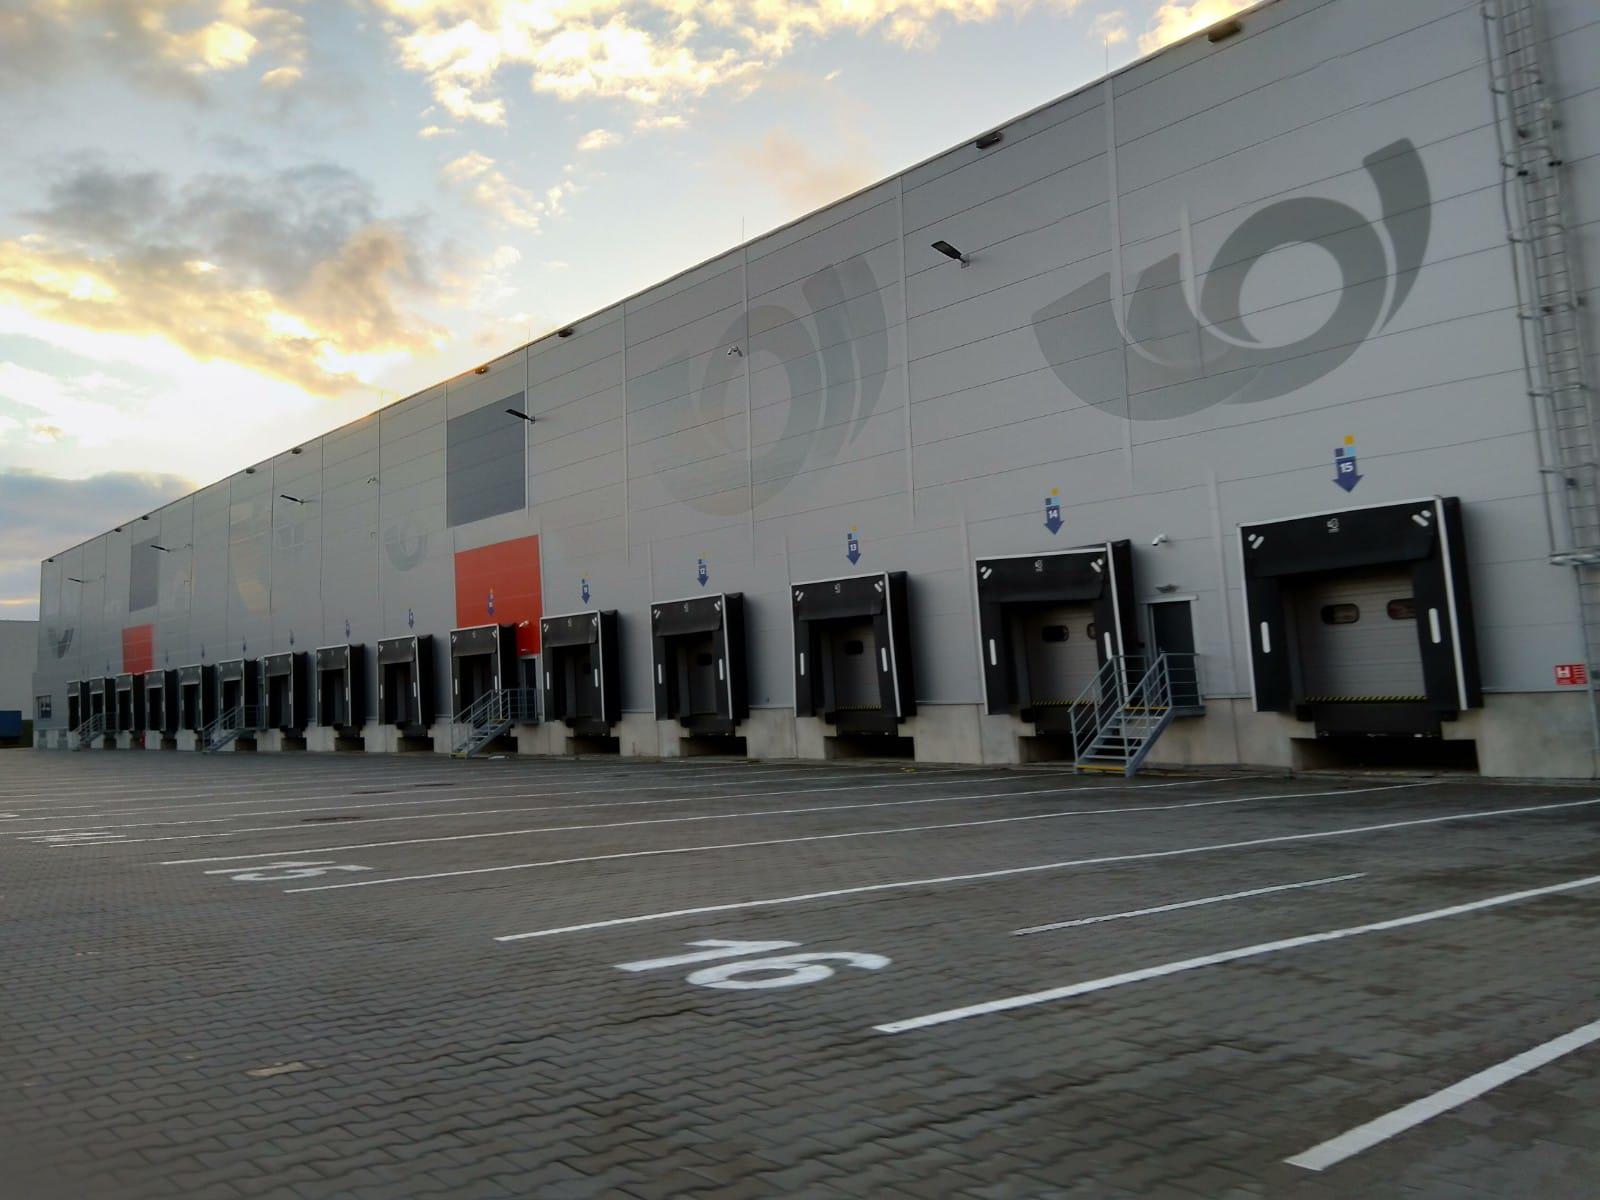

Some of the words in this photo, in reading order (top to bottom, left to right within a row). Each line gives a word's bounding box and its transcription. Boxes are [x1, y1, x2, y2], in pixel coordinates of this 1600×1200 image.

[1340, 462, 1354, 473] 15
[1048, 509, 1058, 519] 14
[202, 861, 375, 881] 15
[611, 939, 893, 989] 16
